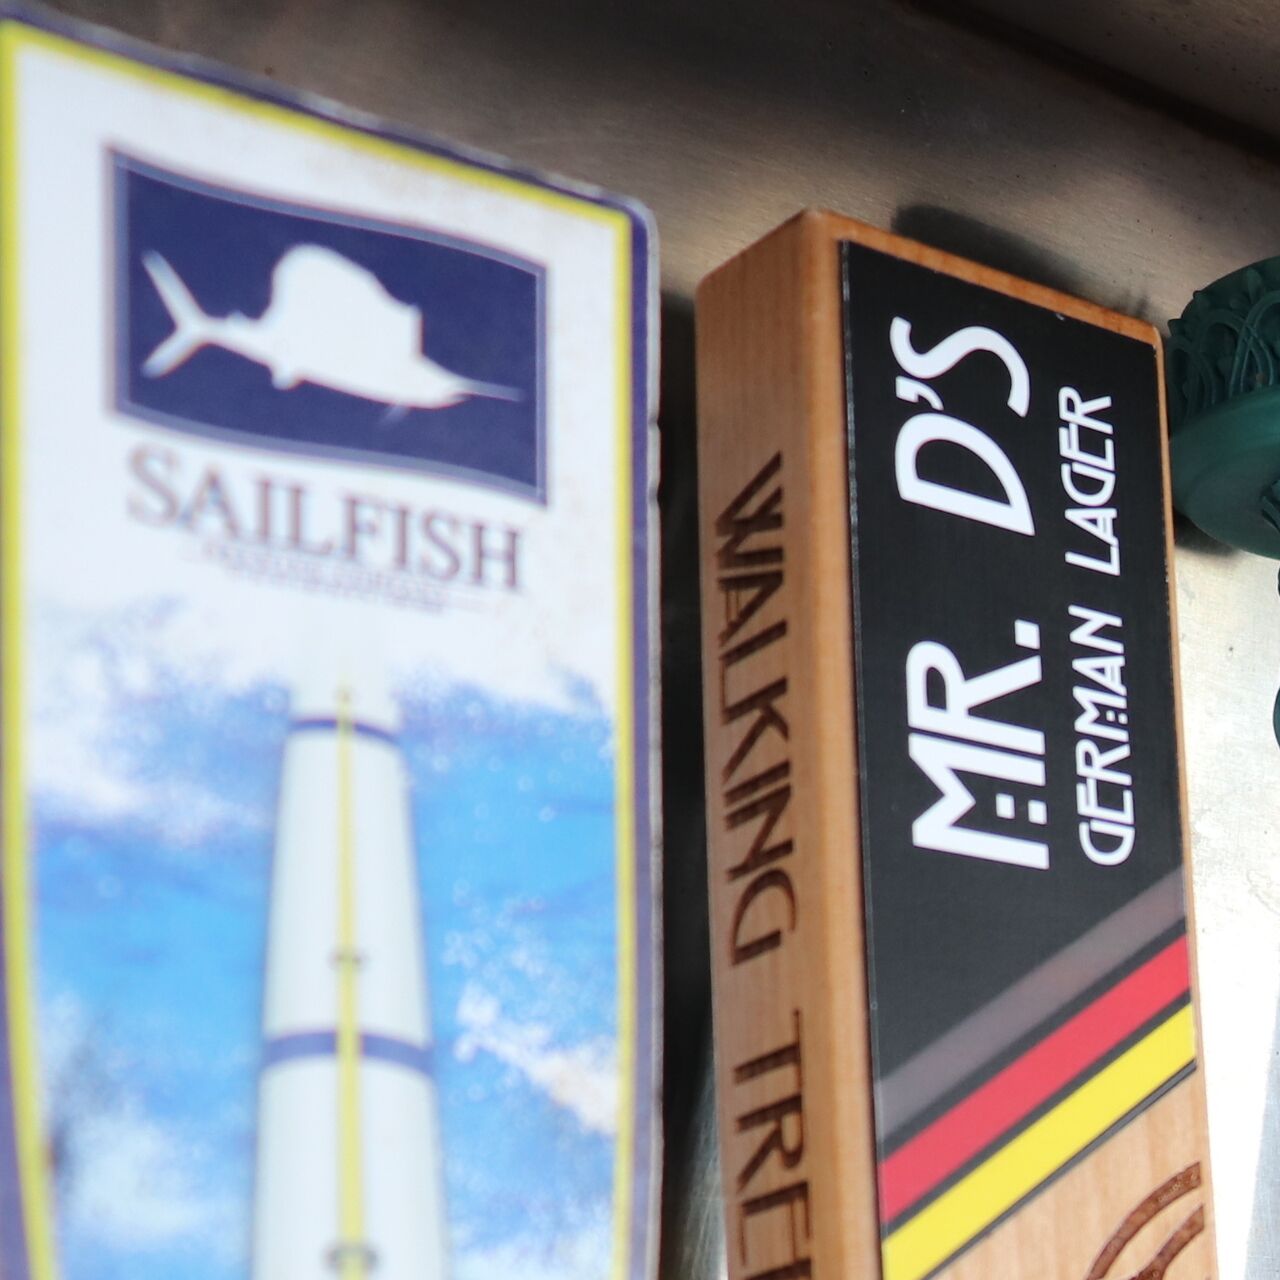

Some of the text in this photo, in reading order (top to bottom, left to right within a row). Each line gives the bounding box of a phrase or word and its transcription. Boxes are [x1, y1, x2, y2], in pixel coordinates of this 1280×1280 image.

[127, 443, 521, 592] SAILFISH
[713, 450, 797, 966] WALKING
[889, 316, 1050, 870] MR. D'S
[1058, 386, 1135, 867] GERMAN LAGER
